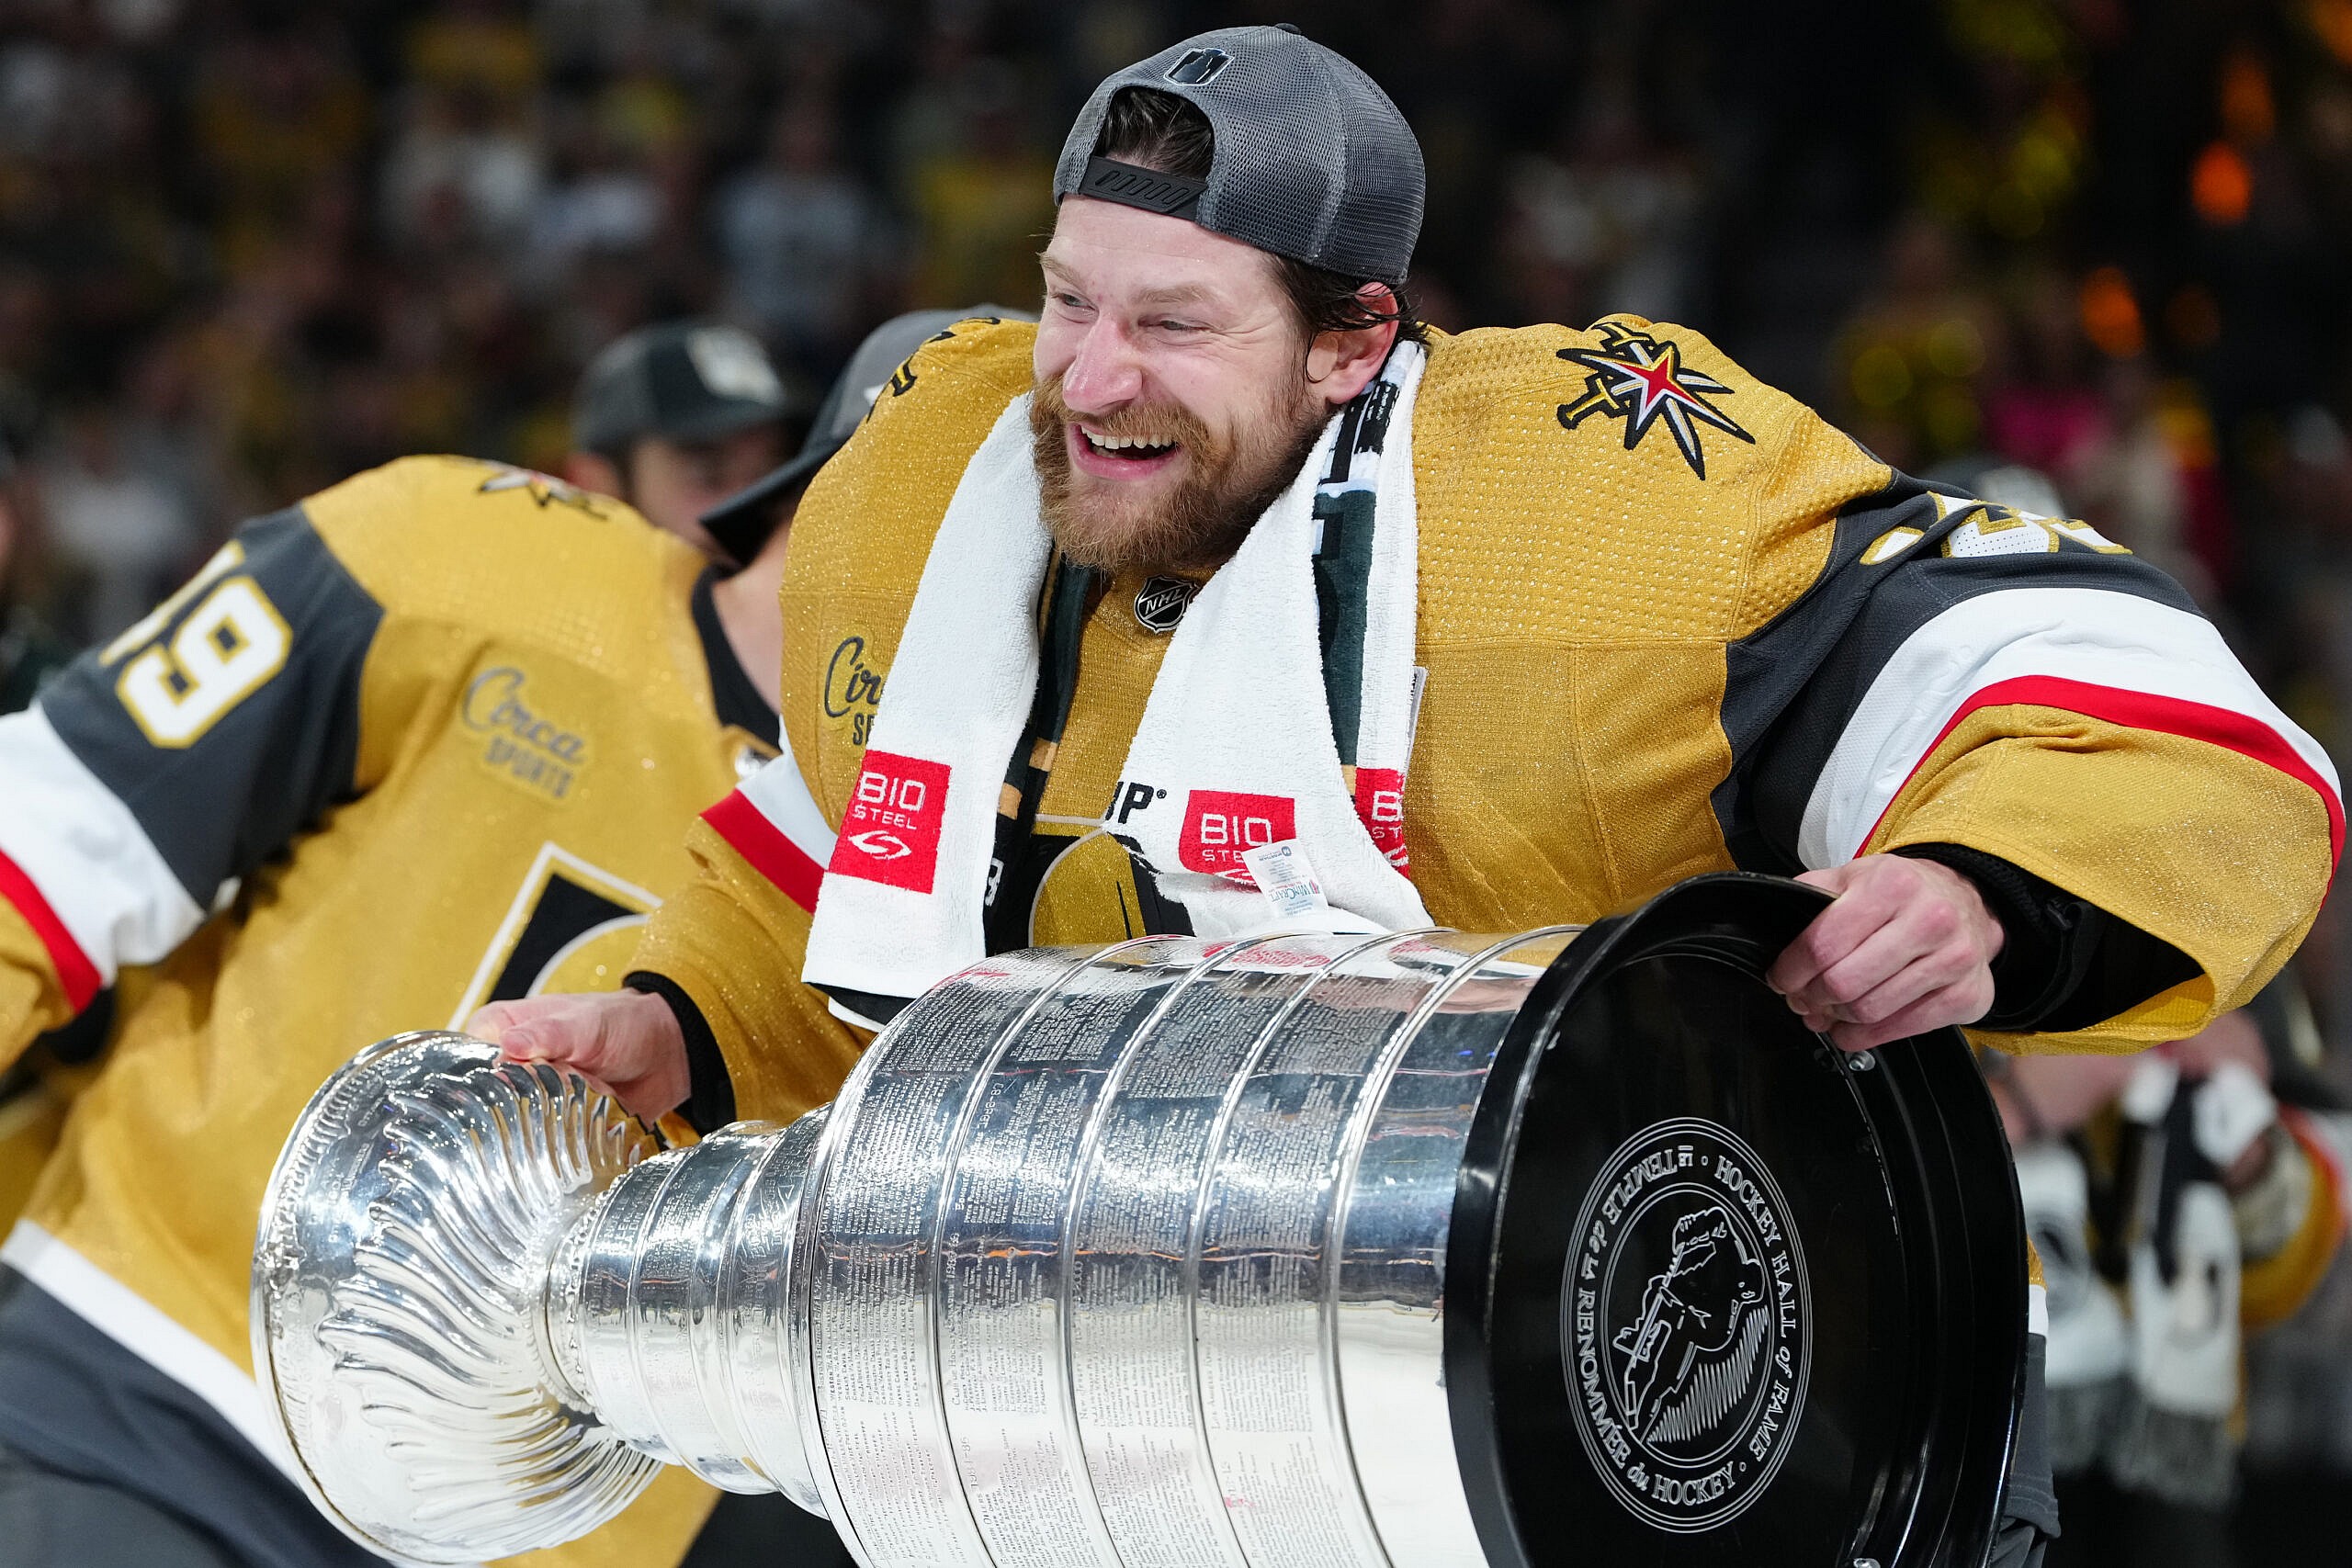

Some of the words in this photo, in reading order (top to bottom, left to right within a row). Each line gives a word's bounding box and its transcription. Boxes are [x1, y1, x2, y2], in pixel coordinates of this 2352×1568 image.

[1145, 589, 1183, 615] NHL
[824, 636, 885, 717] Cir
[462, 666, 586, 764] Circa
[856, 771, 926, 812] BIO
[852, 804, 917, 830] STEEL
[1201, 813, 1272, 847] BIO
[1202, 848, 1243, 863] STE
[1601, 1149, 1679, 1225] TEMPLE
[1713, 1155, 1781, 1247] HOCKEY
[1589, 1220, 1608, 1254] de
[1580, 1252, 1600, 1280] LA
[1771, 1250, 1796, 1338] HALL
[1775, 1346, 1792, 1380] of
[1748, 1379, 1791, 1462] FAME
[1627, 1462, 1650, 1491] du
[1651, 1461, 1736, 1506] HOCKEY
